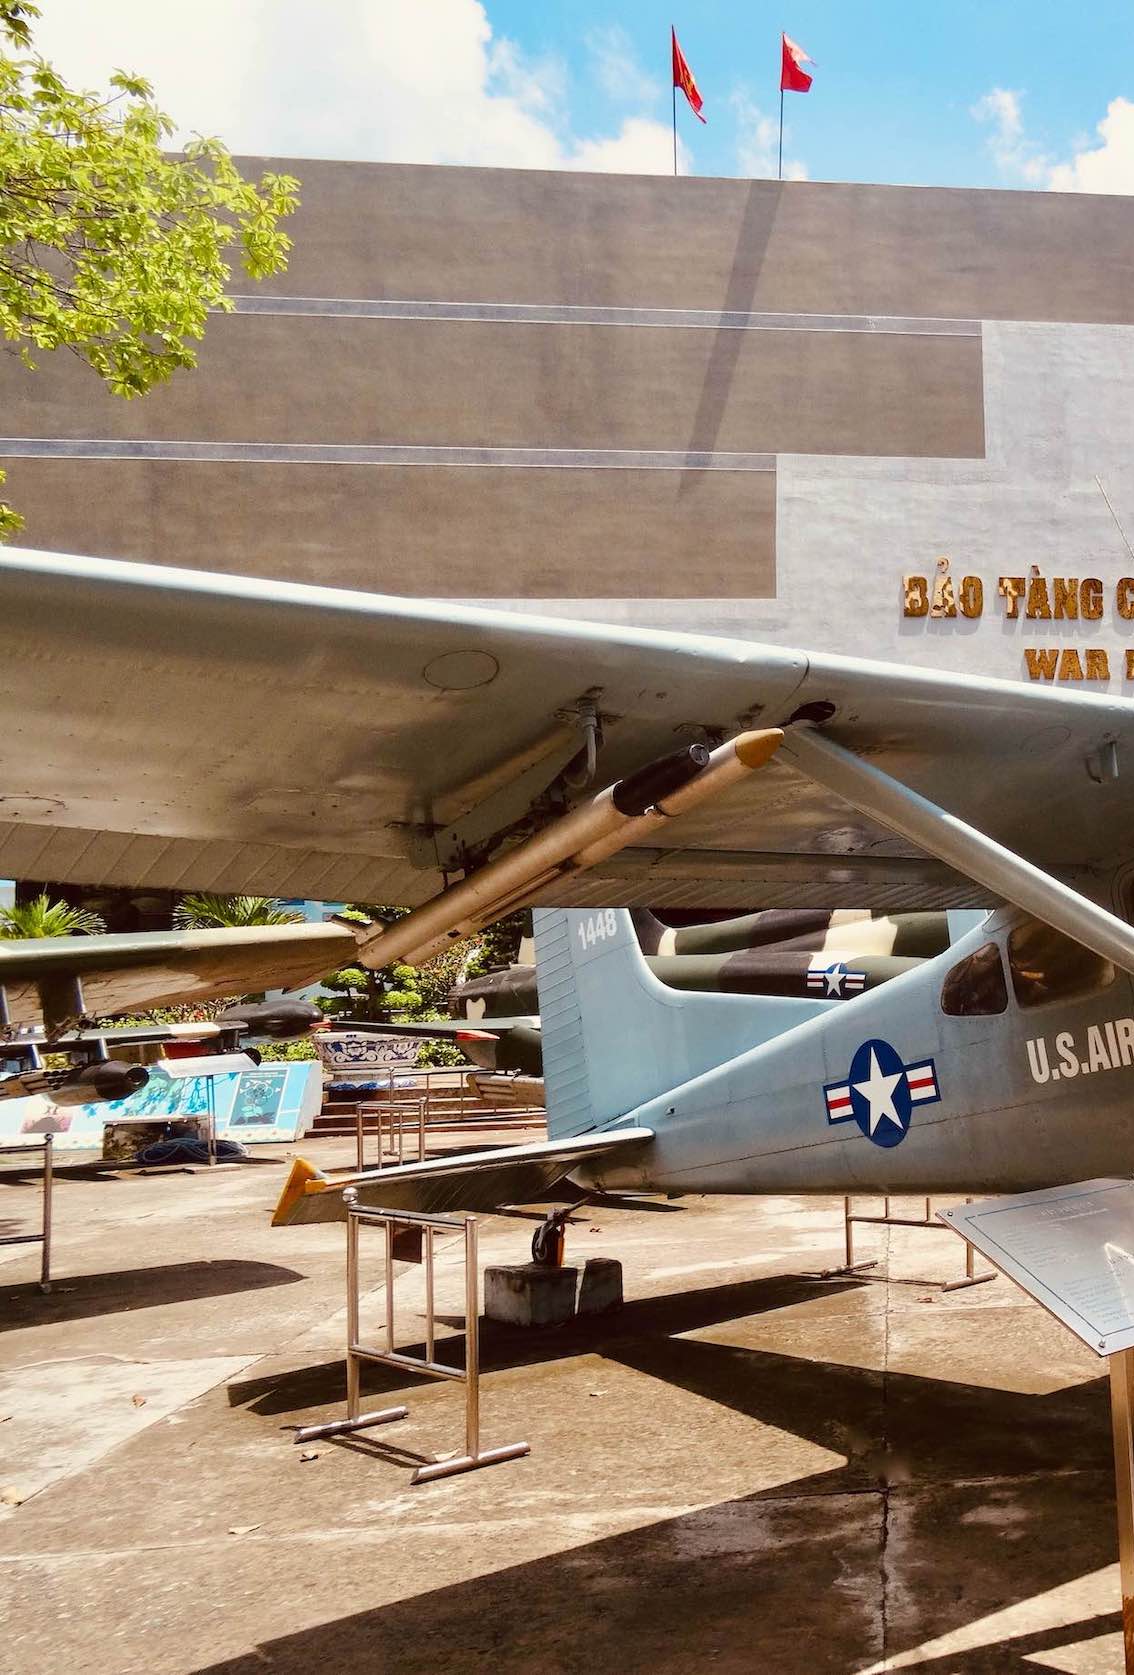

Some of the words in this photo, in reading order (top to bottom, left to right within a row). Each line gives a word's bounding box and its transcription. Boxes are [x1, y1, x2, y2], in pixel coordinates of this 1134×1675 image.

[903, 555, 983, 619] BẢO
[999, 565, 1103, 620] TÀNG
[1024, 648, 1110, 681] WAR
[578, 908, 617, 950] 1448
